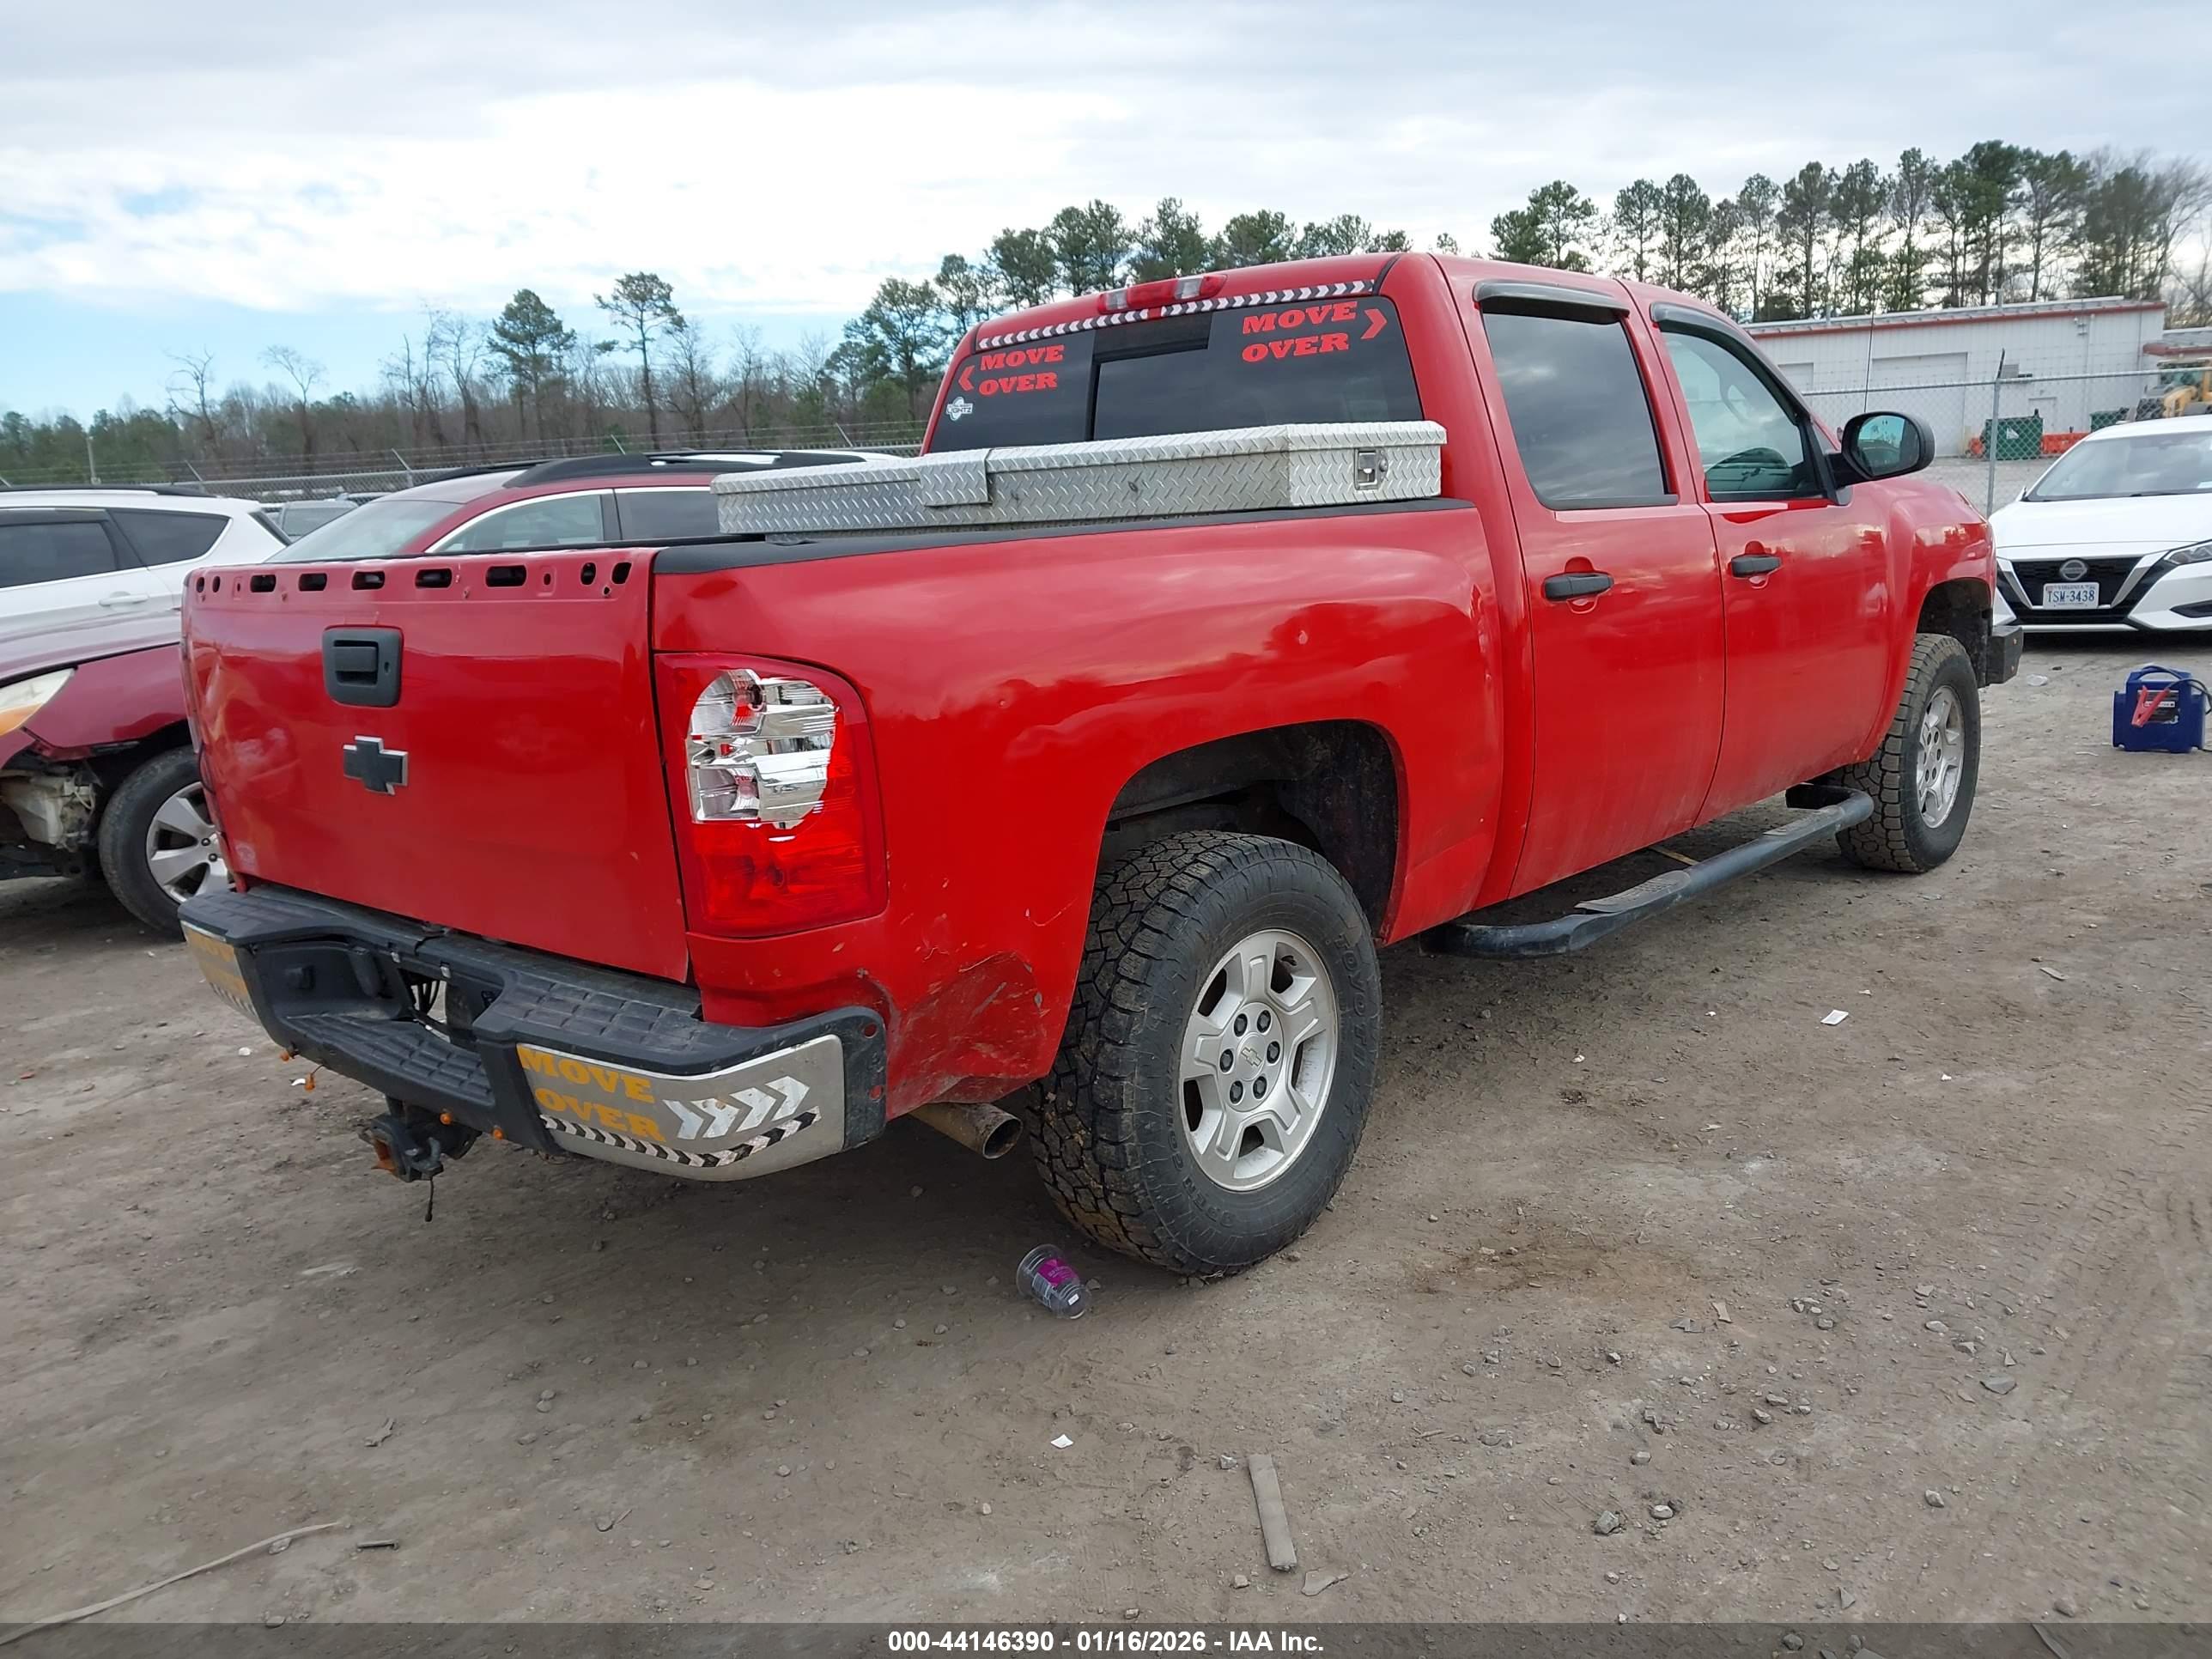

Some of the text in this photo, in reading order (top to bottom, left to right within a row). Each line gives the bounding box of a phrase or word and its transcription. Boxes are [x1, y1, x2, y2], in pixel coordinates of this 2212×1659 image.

[1242, 301, 1358, 335] MOVE
[980, 344, 1065, 371] MOVE
[1242, 332, 1350, 362] OVER
[978, 372, 1058, 396] OVER
[517, 1043, 655, 1104] MOVE
[535, 1087, 667, 1143] OVER
